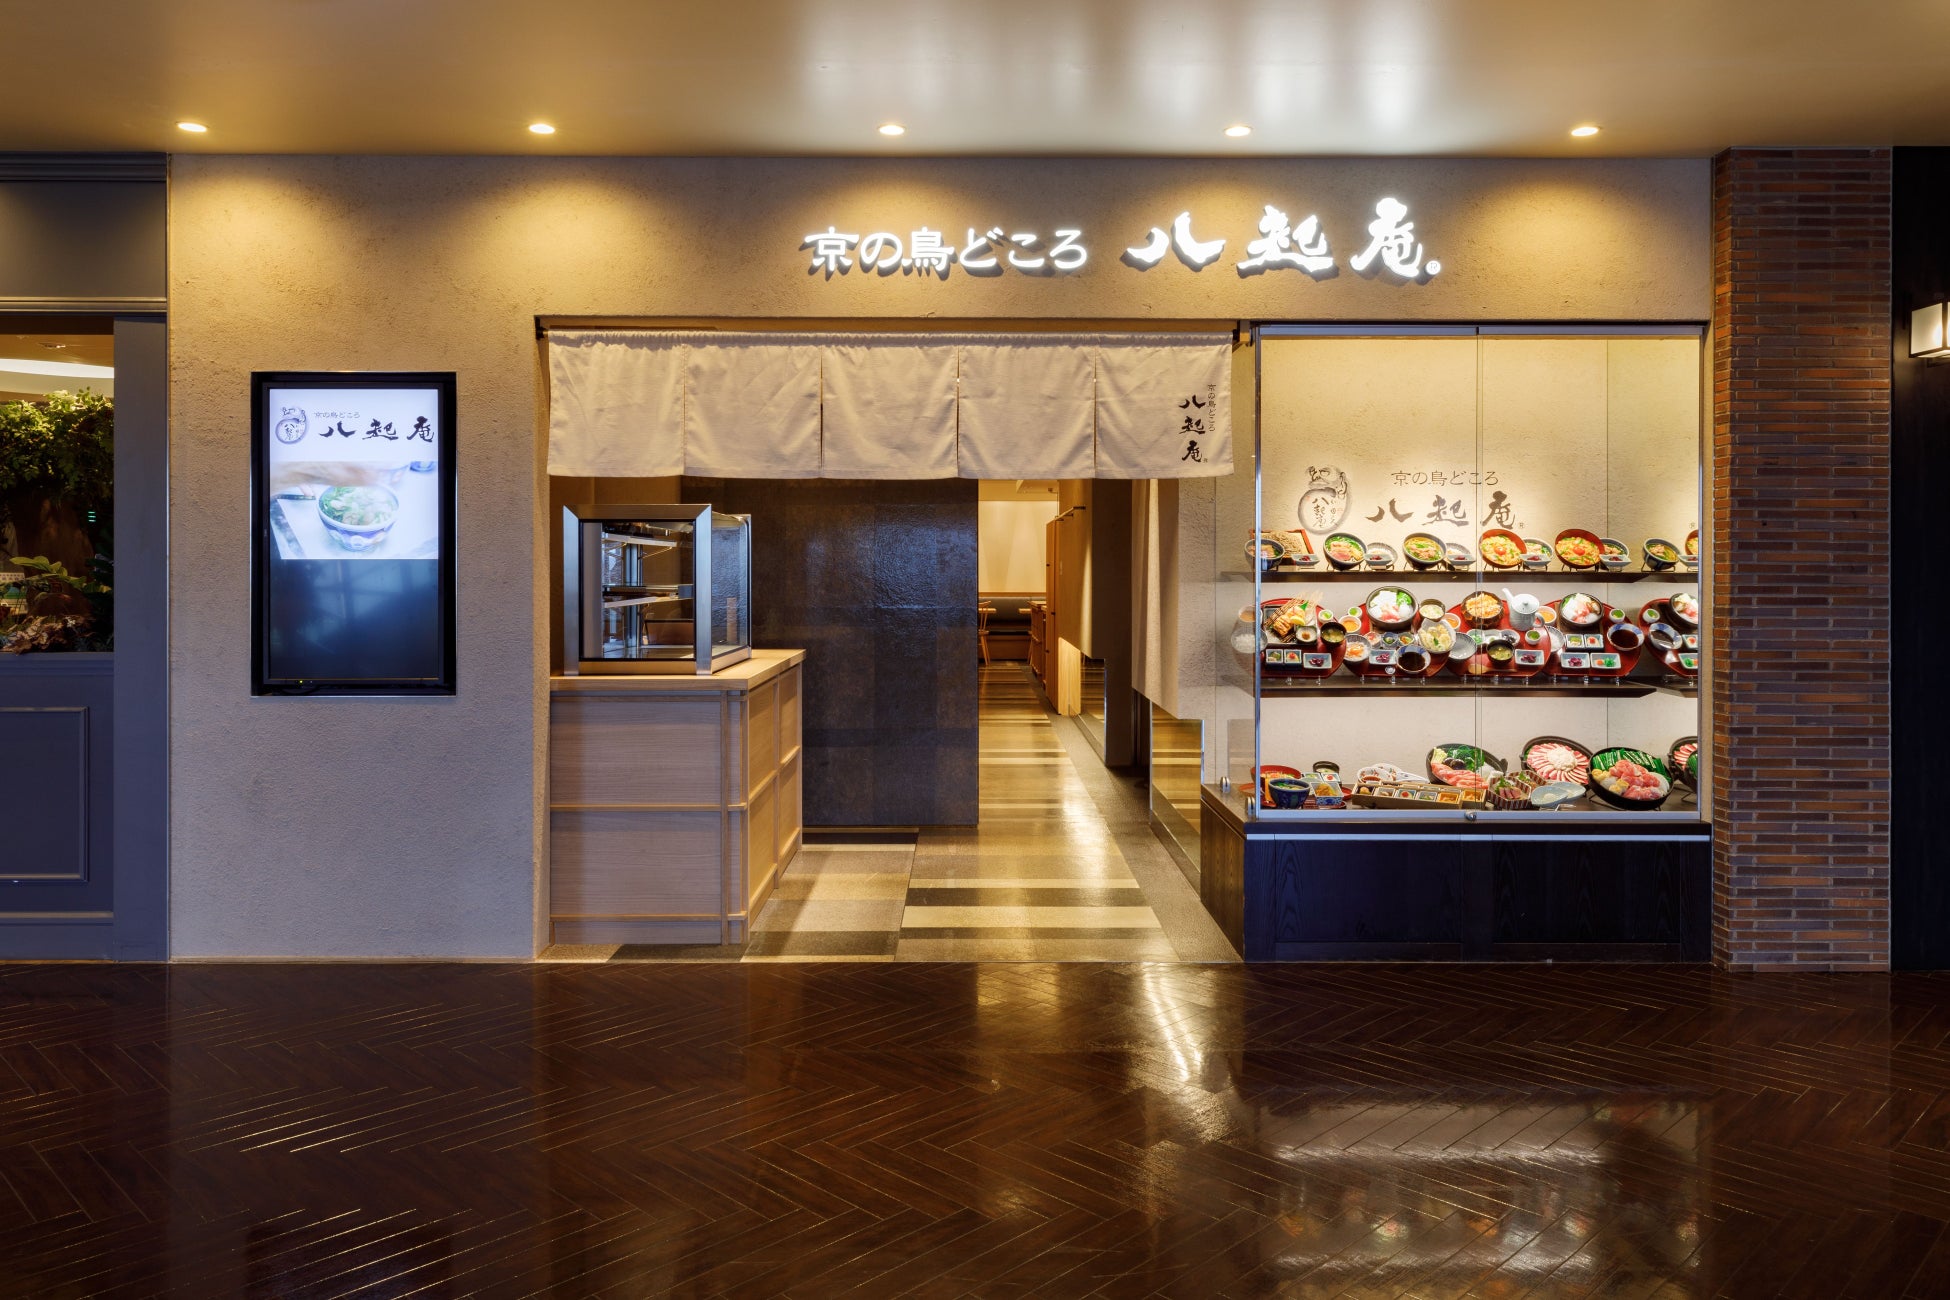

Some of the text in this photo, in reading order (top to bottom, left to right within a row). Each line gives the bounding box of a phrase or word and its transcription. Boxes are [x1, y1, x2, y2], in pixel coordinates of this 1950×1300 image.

[804, 226, 1088, 271] 京の鳥どころ
[318, 416, 435, 442] 八起庵
[1178, 395, 1206, 463] 八起庵
[1207, 383, 1217, 432] 京の鳥どころ
[1391, 470, 1499, 487] 京の鳥どころ
